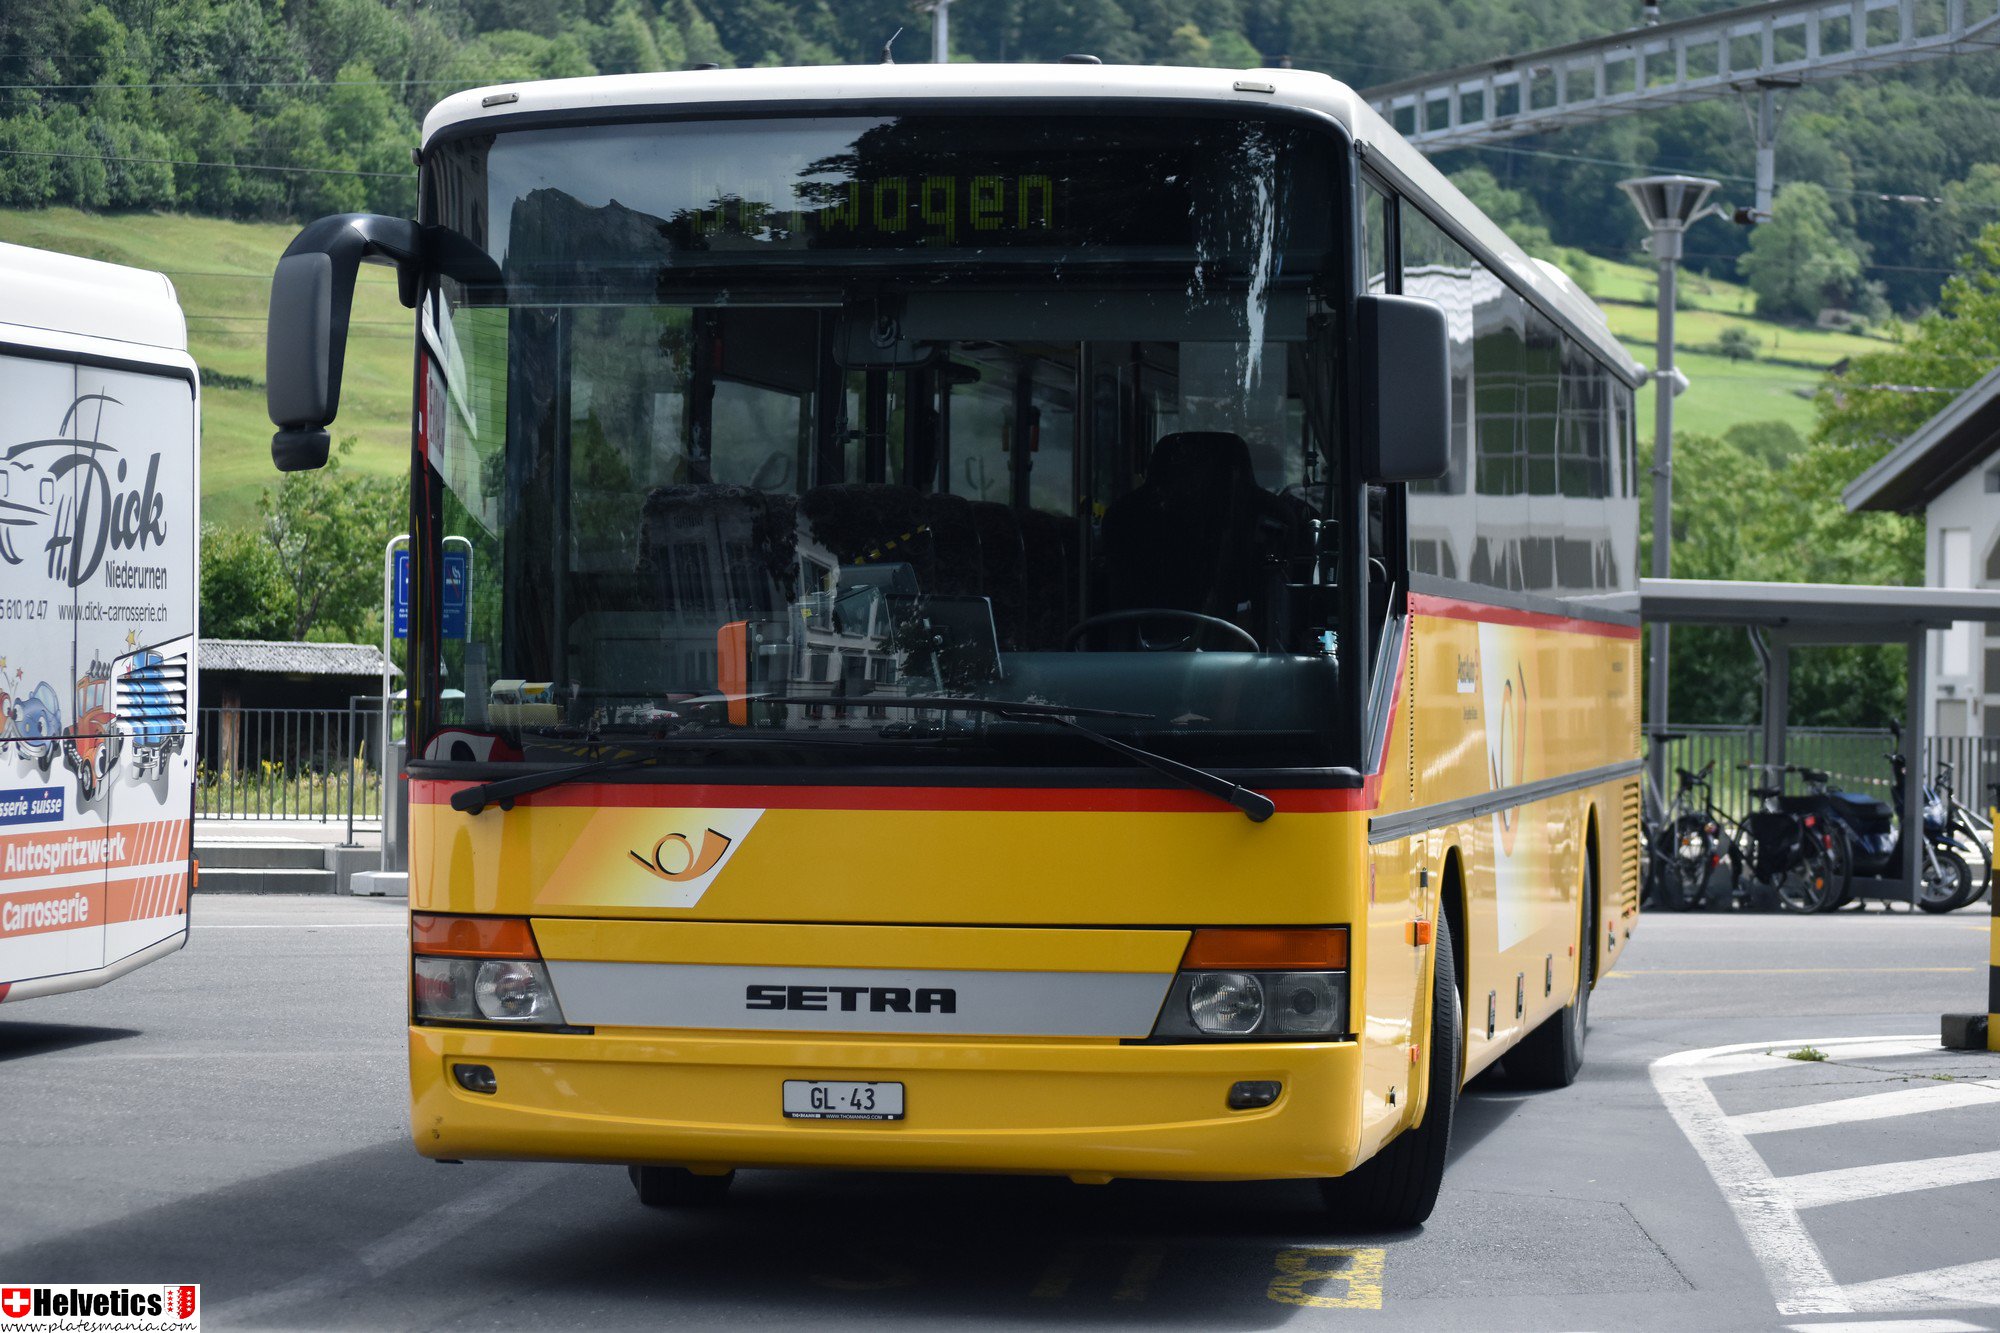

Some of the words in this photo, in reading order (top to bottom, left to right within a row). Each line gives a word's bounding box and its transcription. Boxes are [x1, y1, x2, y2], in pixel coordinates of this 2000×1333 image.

[105, 560, 168, 590] Niederurnen
[7, 599, 22, 619] 610
[25, 599, 34, 619] 12
[37, 600, 48, 619] 47
[58, 601, 168, 622] www.dick-carrosserie.ch
[31, 790, 62, 815] suisse
[4, 832, 126, 873] Autospritzwerk
[2, 892, 89, 931] Carrosserie
[746, 985, 957, 1014] SETRA
